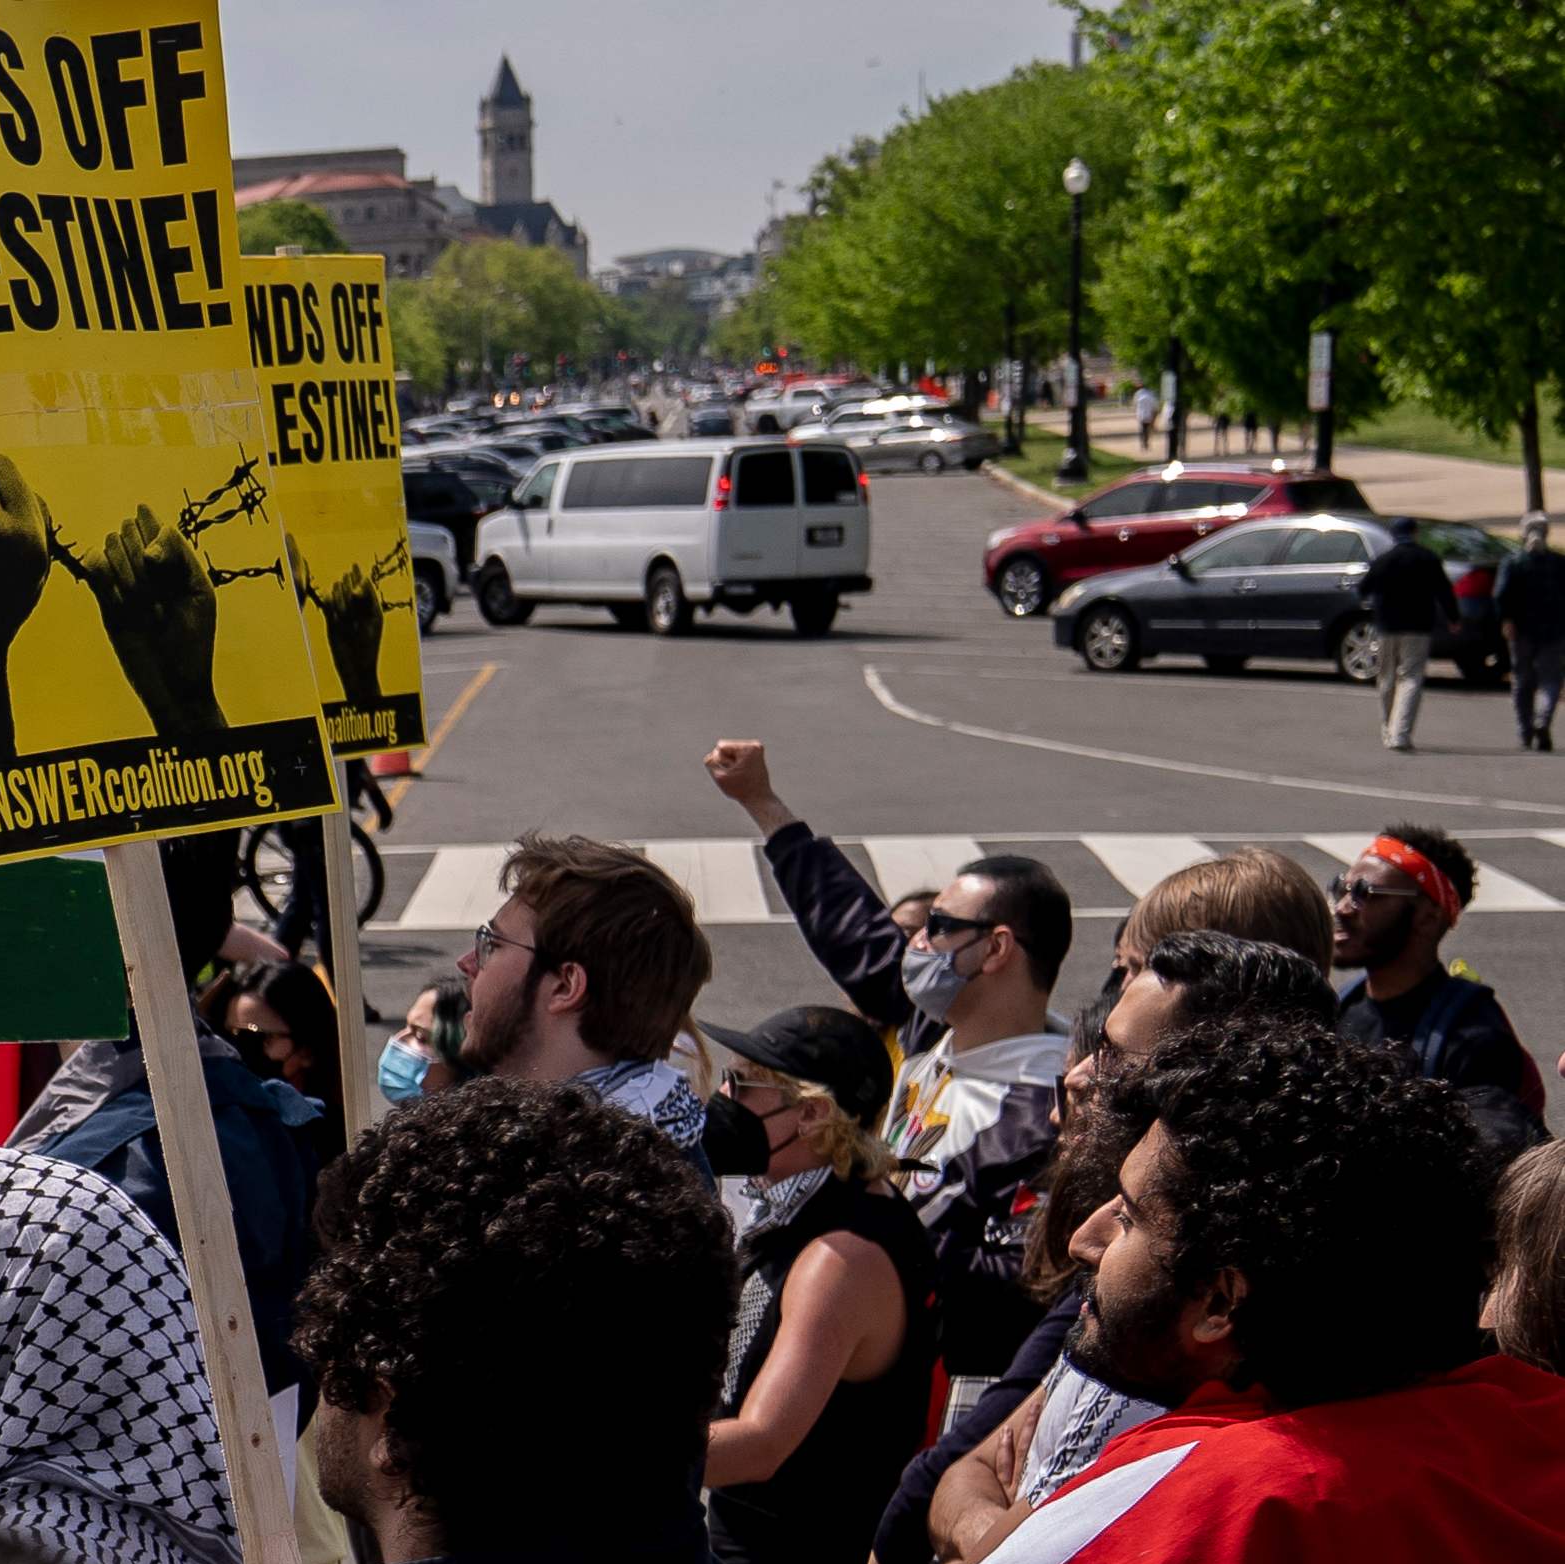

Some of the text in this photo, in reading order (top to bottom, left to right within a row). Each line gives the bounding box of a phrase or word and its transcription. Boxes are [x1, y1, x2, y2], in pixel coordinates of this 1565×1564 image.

[44, 21, 206, 171] OFF
[244, 282, 383, 368] NDS OFF
[268, 380, 396, 466] ESTINE!
[326, 706, 397, 744] oalition.org
